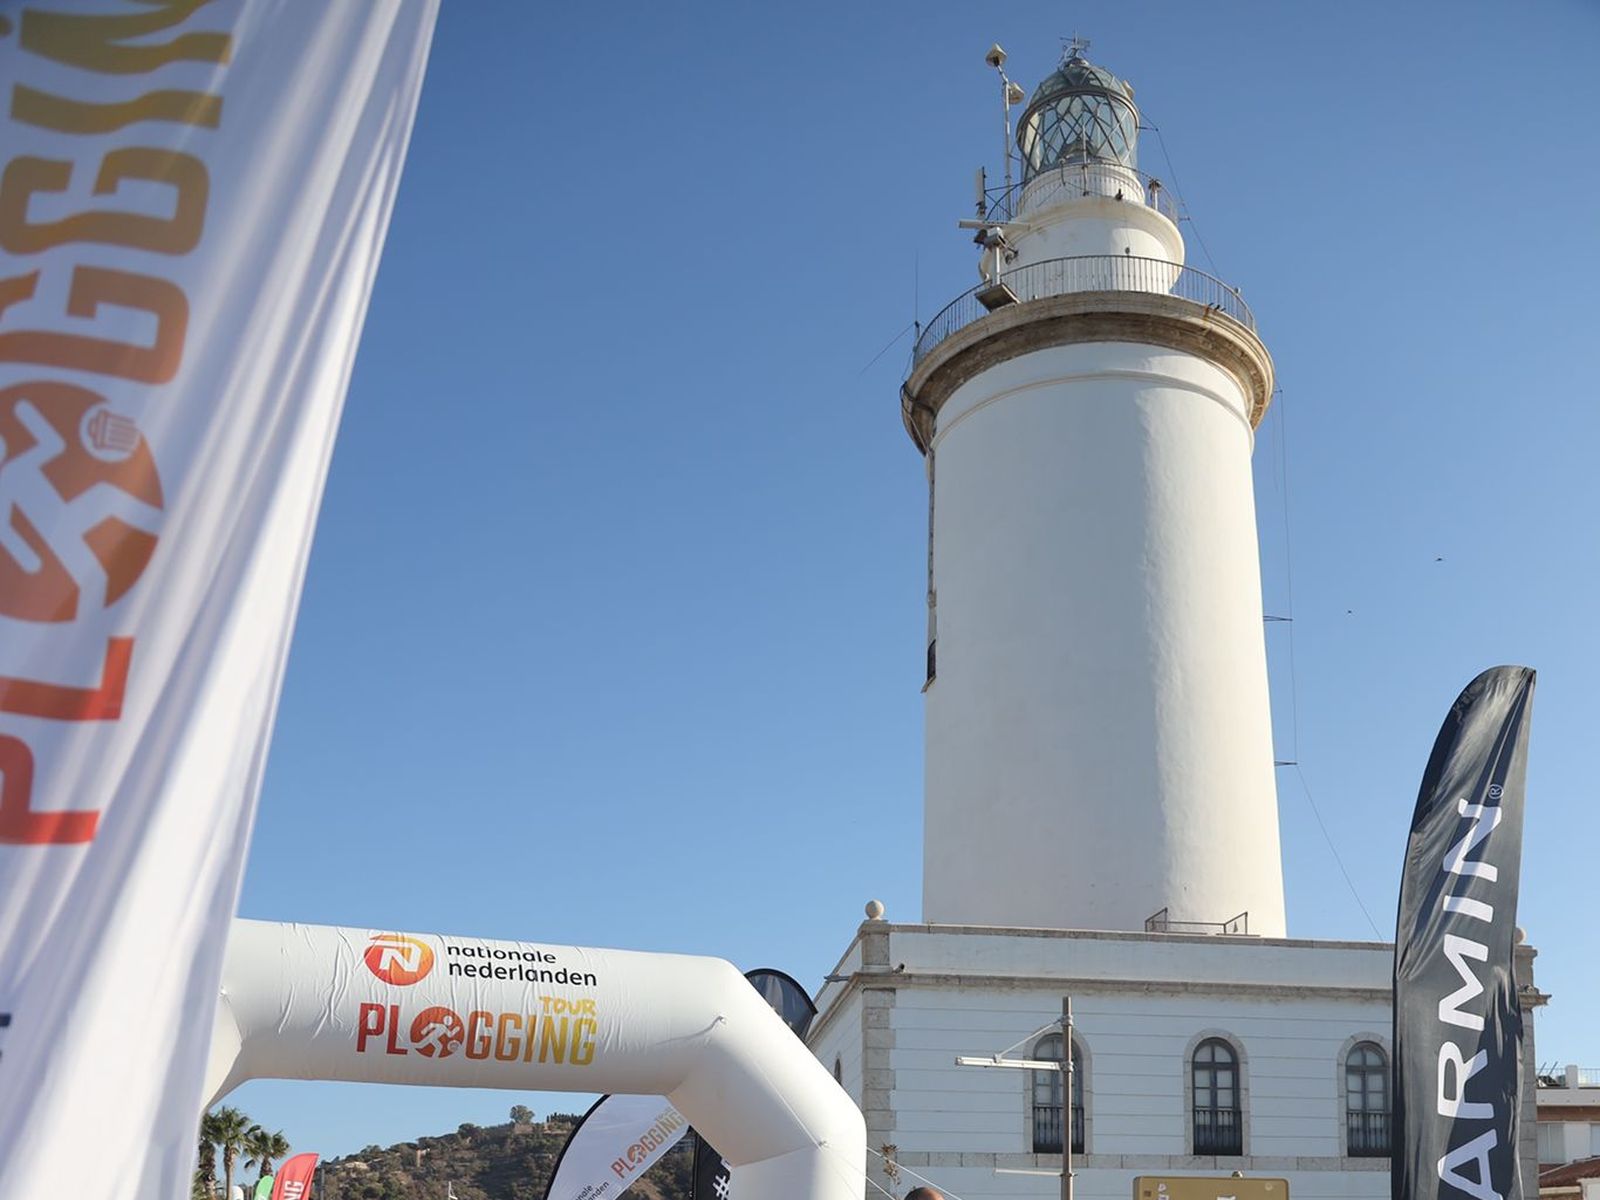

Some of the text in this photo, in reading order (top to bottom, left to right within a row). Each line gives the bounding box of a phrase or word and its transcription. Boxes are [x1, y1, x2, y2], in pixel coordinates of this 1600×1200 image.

[447, 945, 557, 964] nationale
[449, 962, 597, 987] nederlanden
[539, 996, 597, 1015] TOUR
